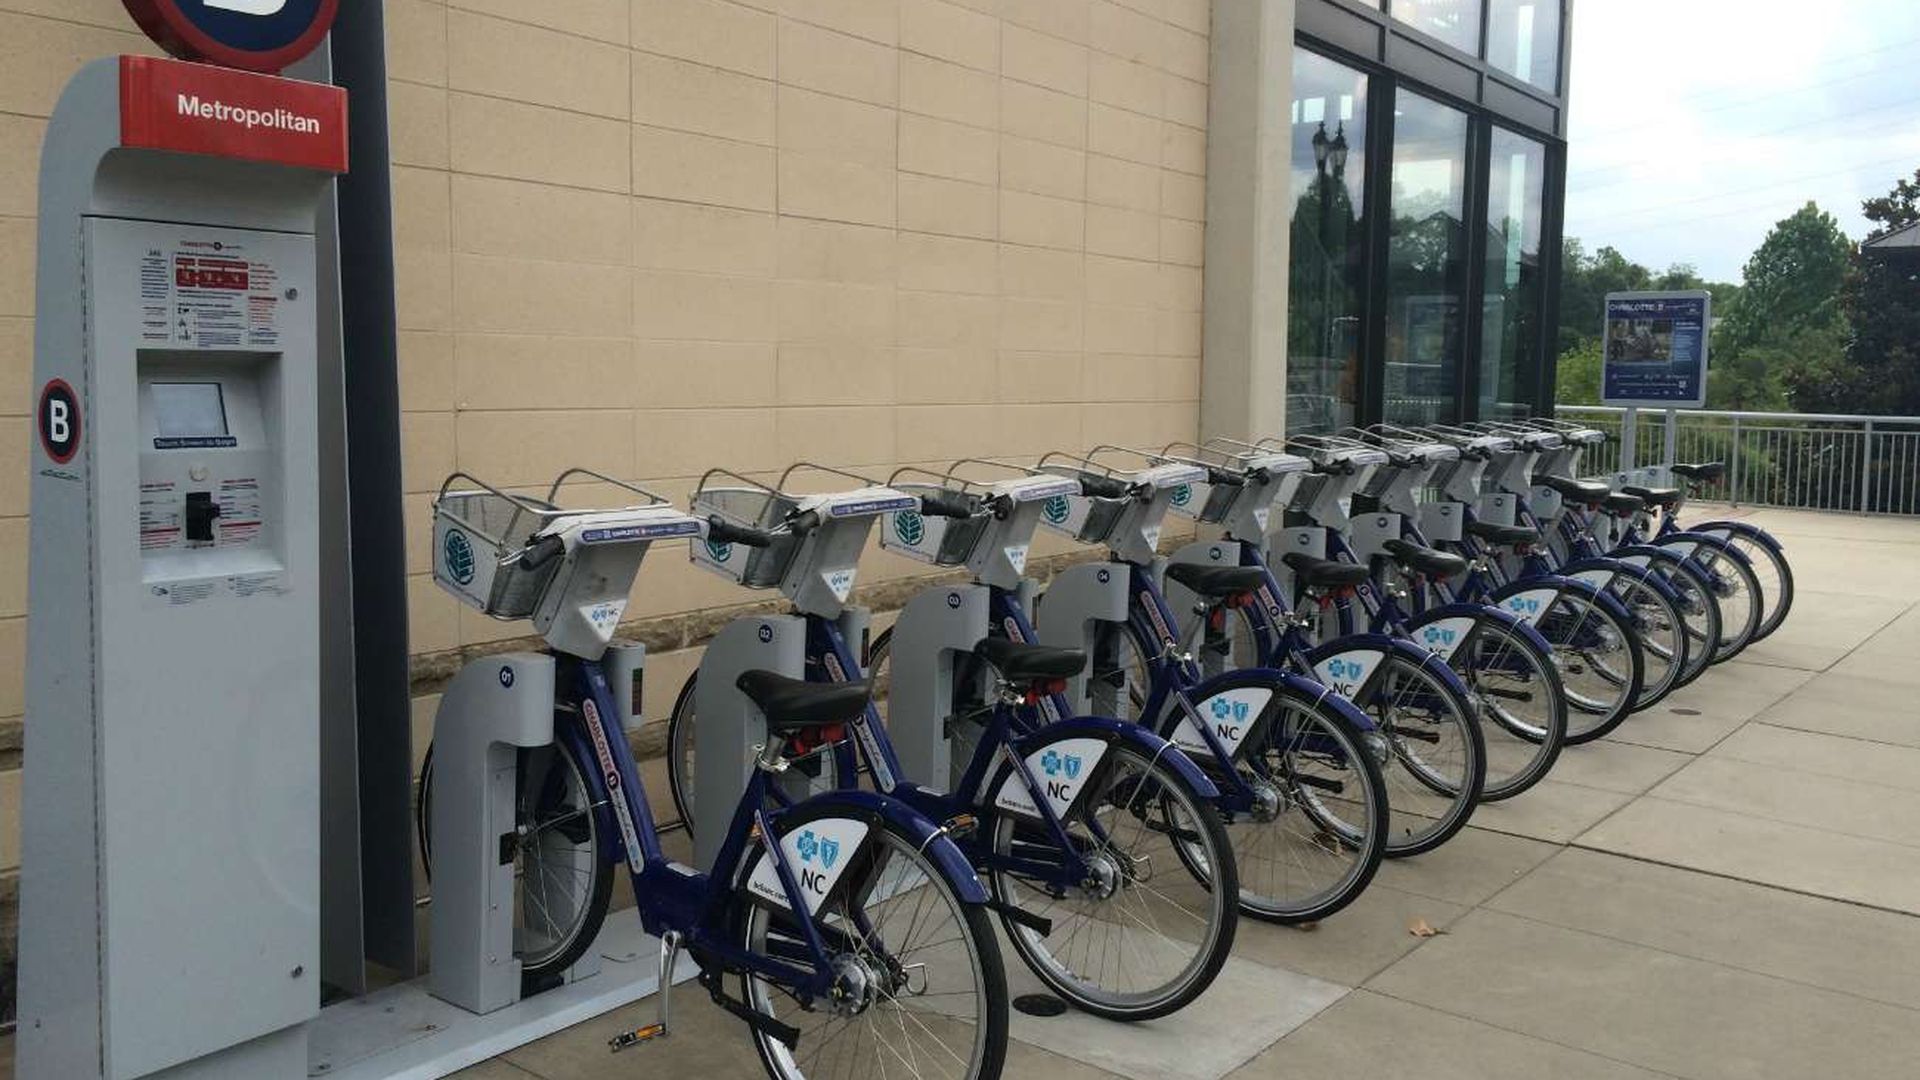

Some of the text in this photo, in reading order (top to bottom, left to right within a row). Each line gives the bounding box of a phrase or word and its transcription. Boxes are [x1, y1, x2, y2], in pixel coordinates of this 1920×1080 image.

[177, 94, 321, 134] Metropolitan
[50, 399, 70, 442] B
[501, 672, 512, 683] 01
[1332, 682, 1353, 697] NC
[1217, 724, 1239, 741] NC
[1047, 780, 1070, 801] NC
[801, 868, 825, 894] NC
